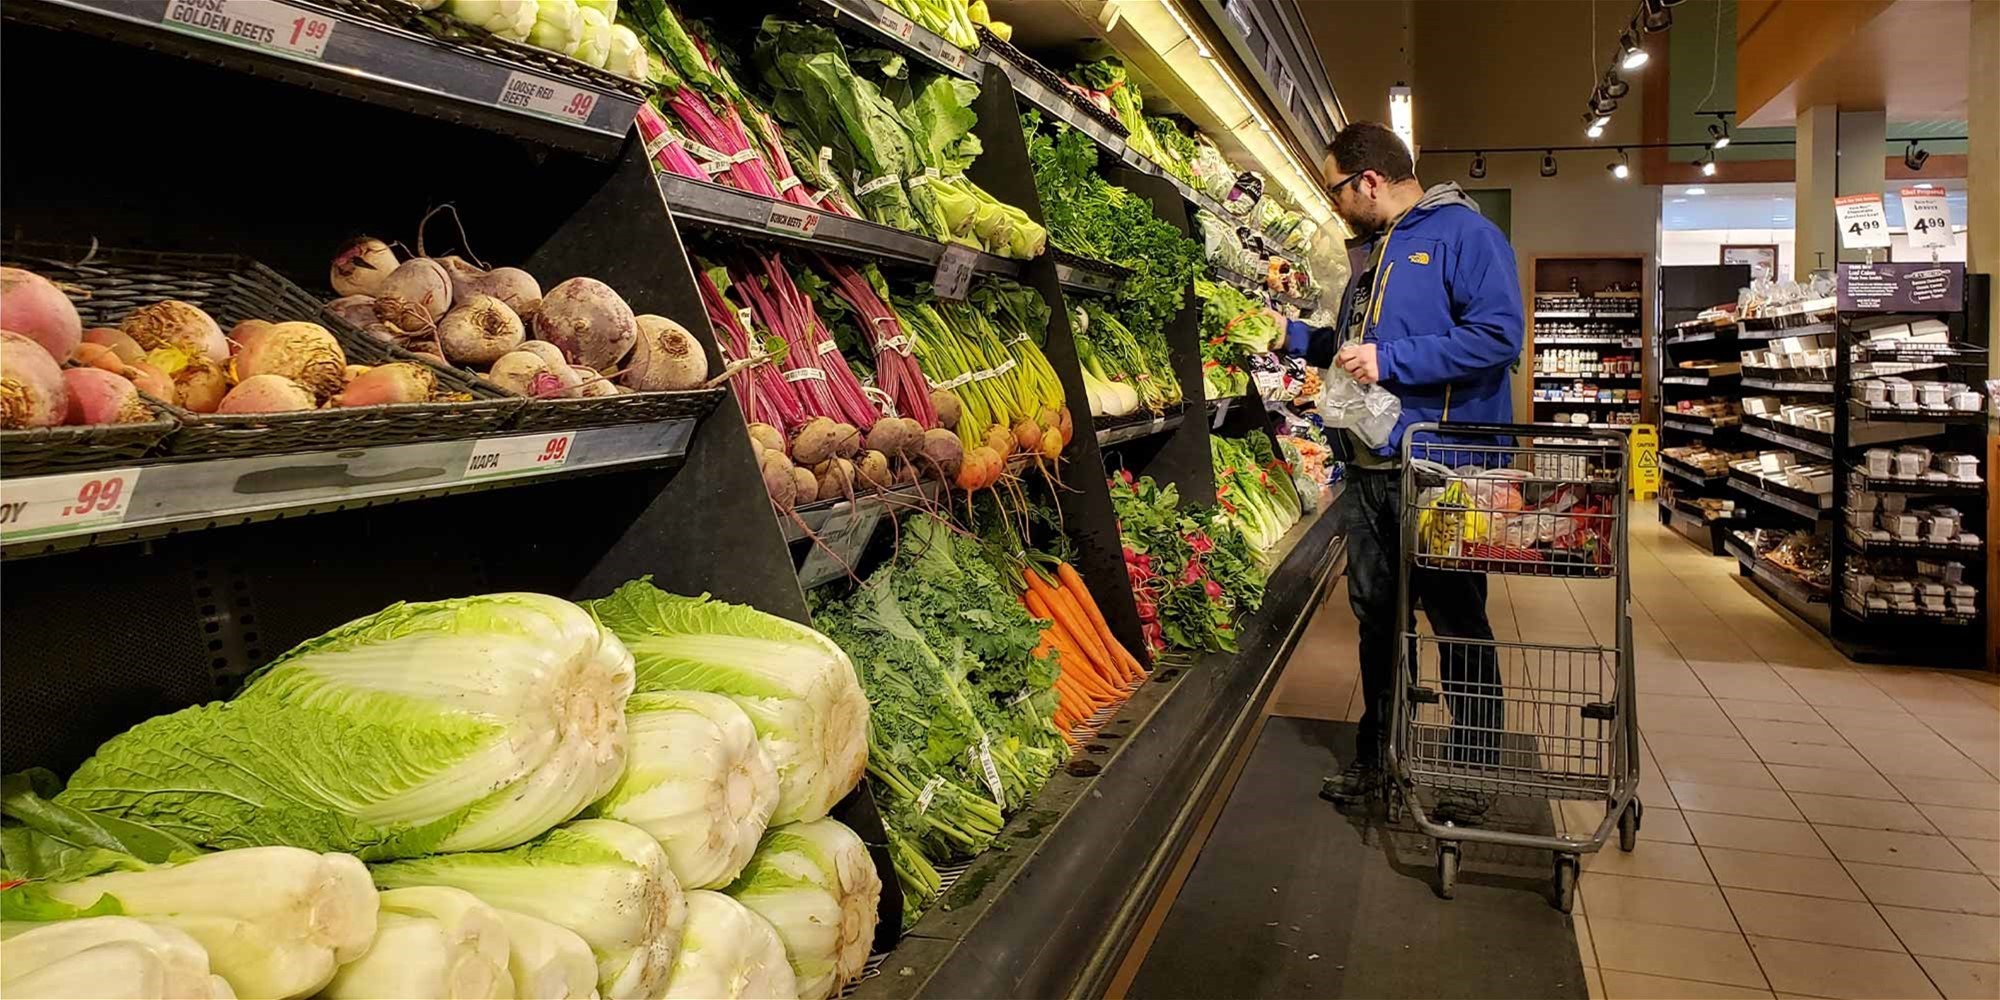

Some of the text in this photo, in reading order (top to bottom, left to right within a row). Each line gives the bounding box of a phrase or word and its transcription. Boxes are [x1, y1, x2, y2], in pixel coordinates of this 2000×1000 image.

[178, 0, 226, 13] OSE
[172, 4, 275, 43] GOLDEN BEETS
[502, 90, 531, 107] BEETS
[508, 78, 554, 100] LOOSE RED
[562, 93, 593, 116] .99
[537, 437, 568, 461] .99
[469, 453, 500, 470] NAPA
[62, 477, 124, 516] .99
